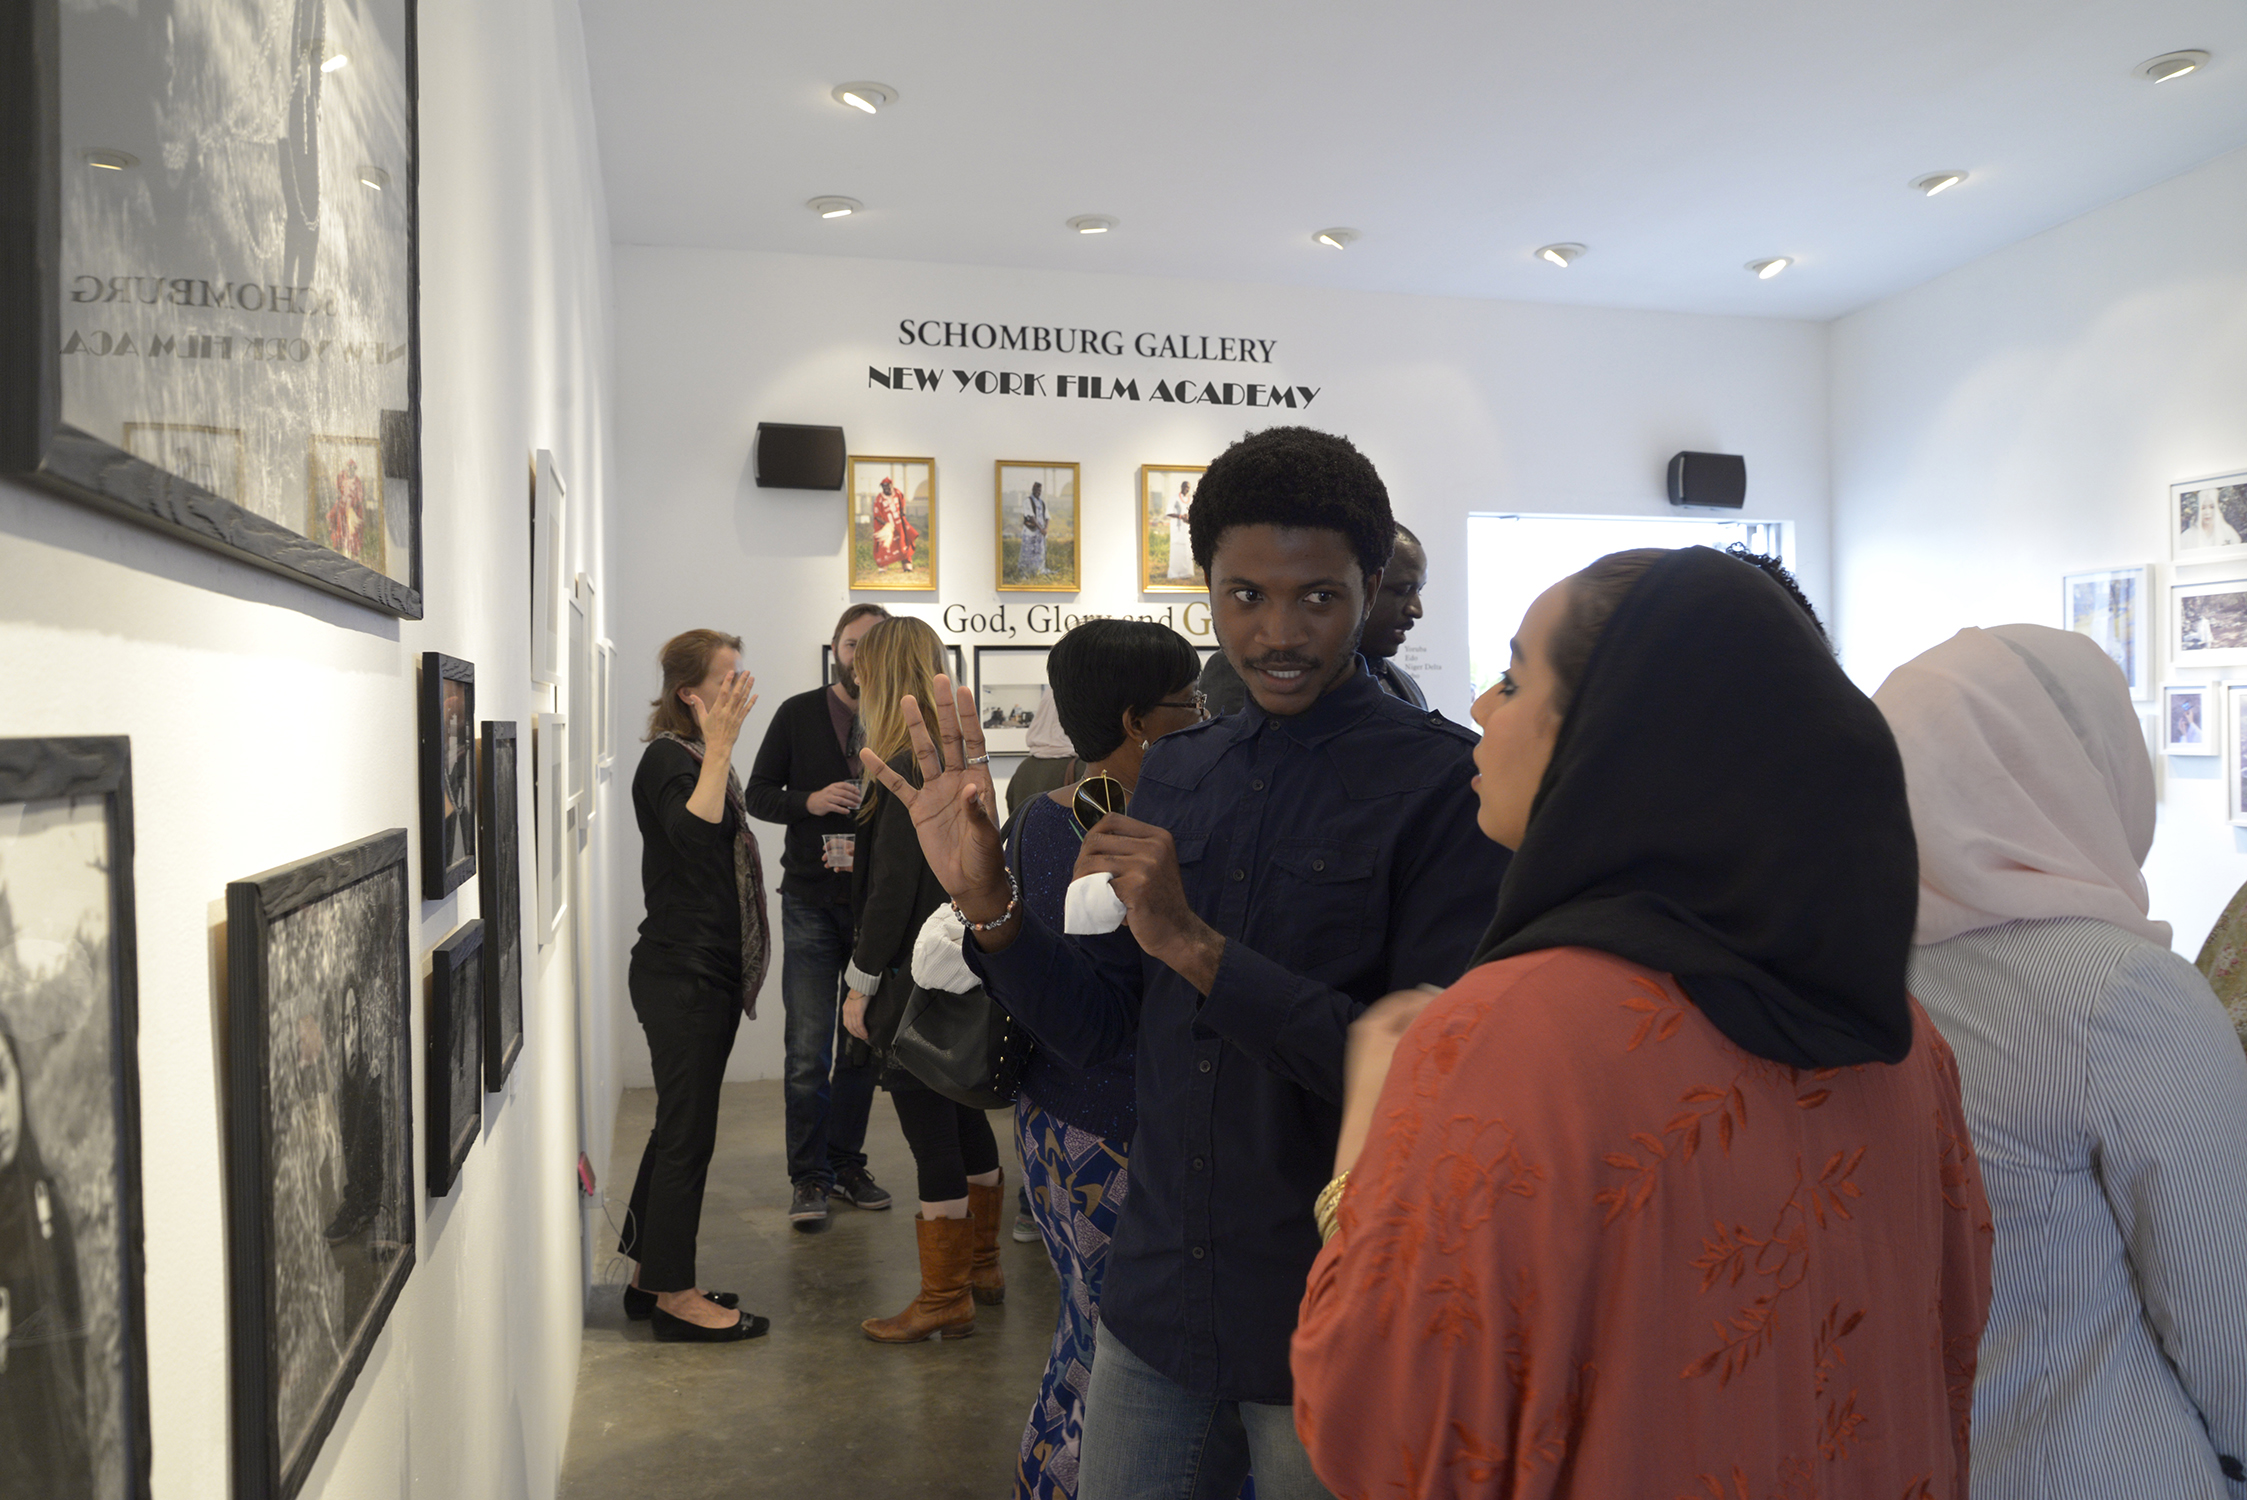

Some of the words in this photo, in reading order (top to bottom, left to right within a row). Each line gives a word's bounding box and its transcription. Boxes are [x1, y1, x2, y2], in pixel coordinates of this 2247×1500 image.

[898, 318, 1125, 357] SCHOMBURG
[1134, 331, 1278, 365] GALLERY
[868, 365, 944, 393] NEW
[952, 369, 1047, 398] YORK
[1056, 374, 1141, 402] FILM
[1149, 377, 1321, 410] ACADEMY
[943, 603, 1016, 638] God,
[1027, 604, 1112, 634] Glo
